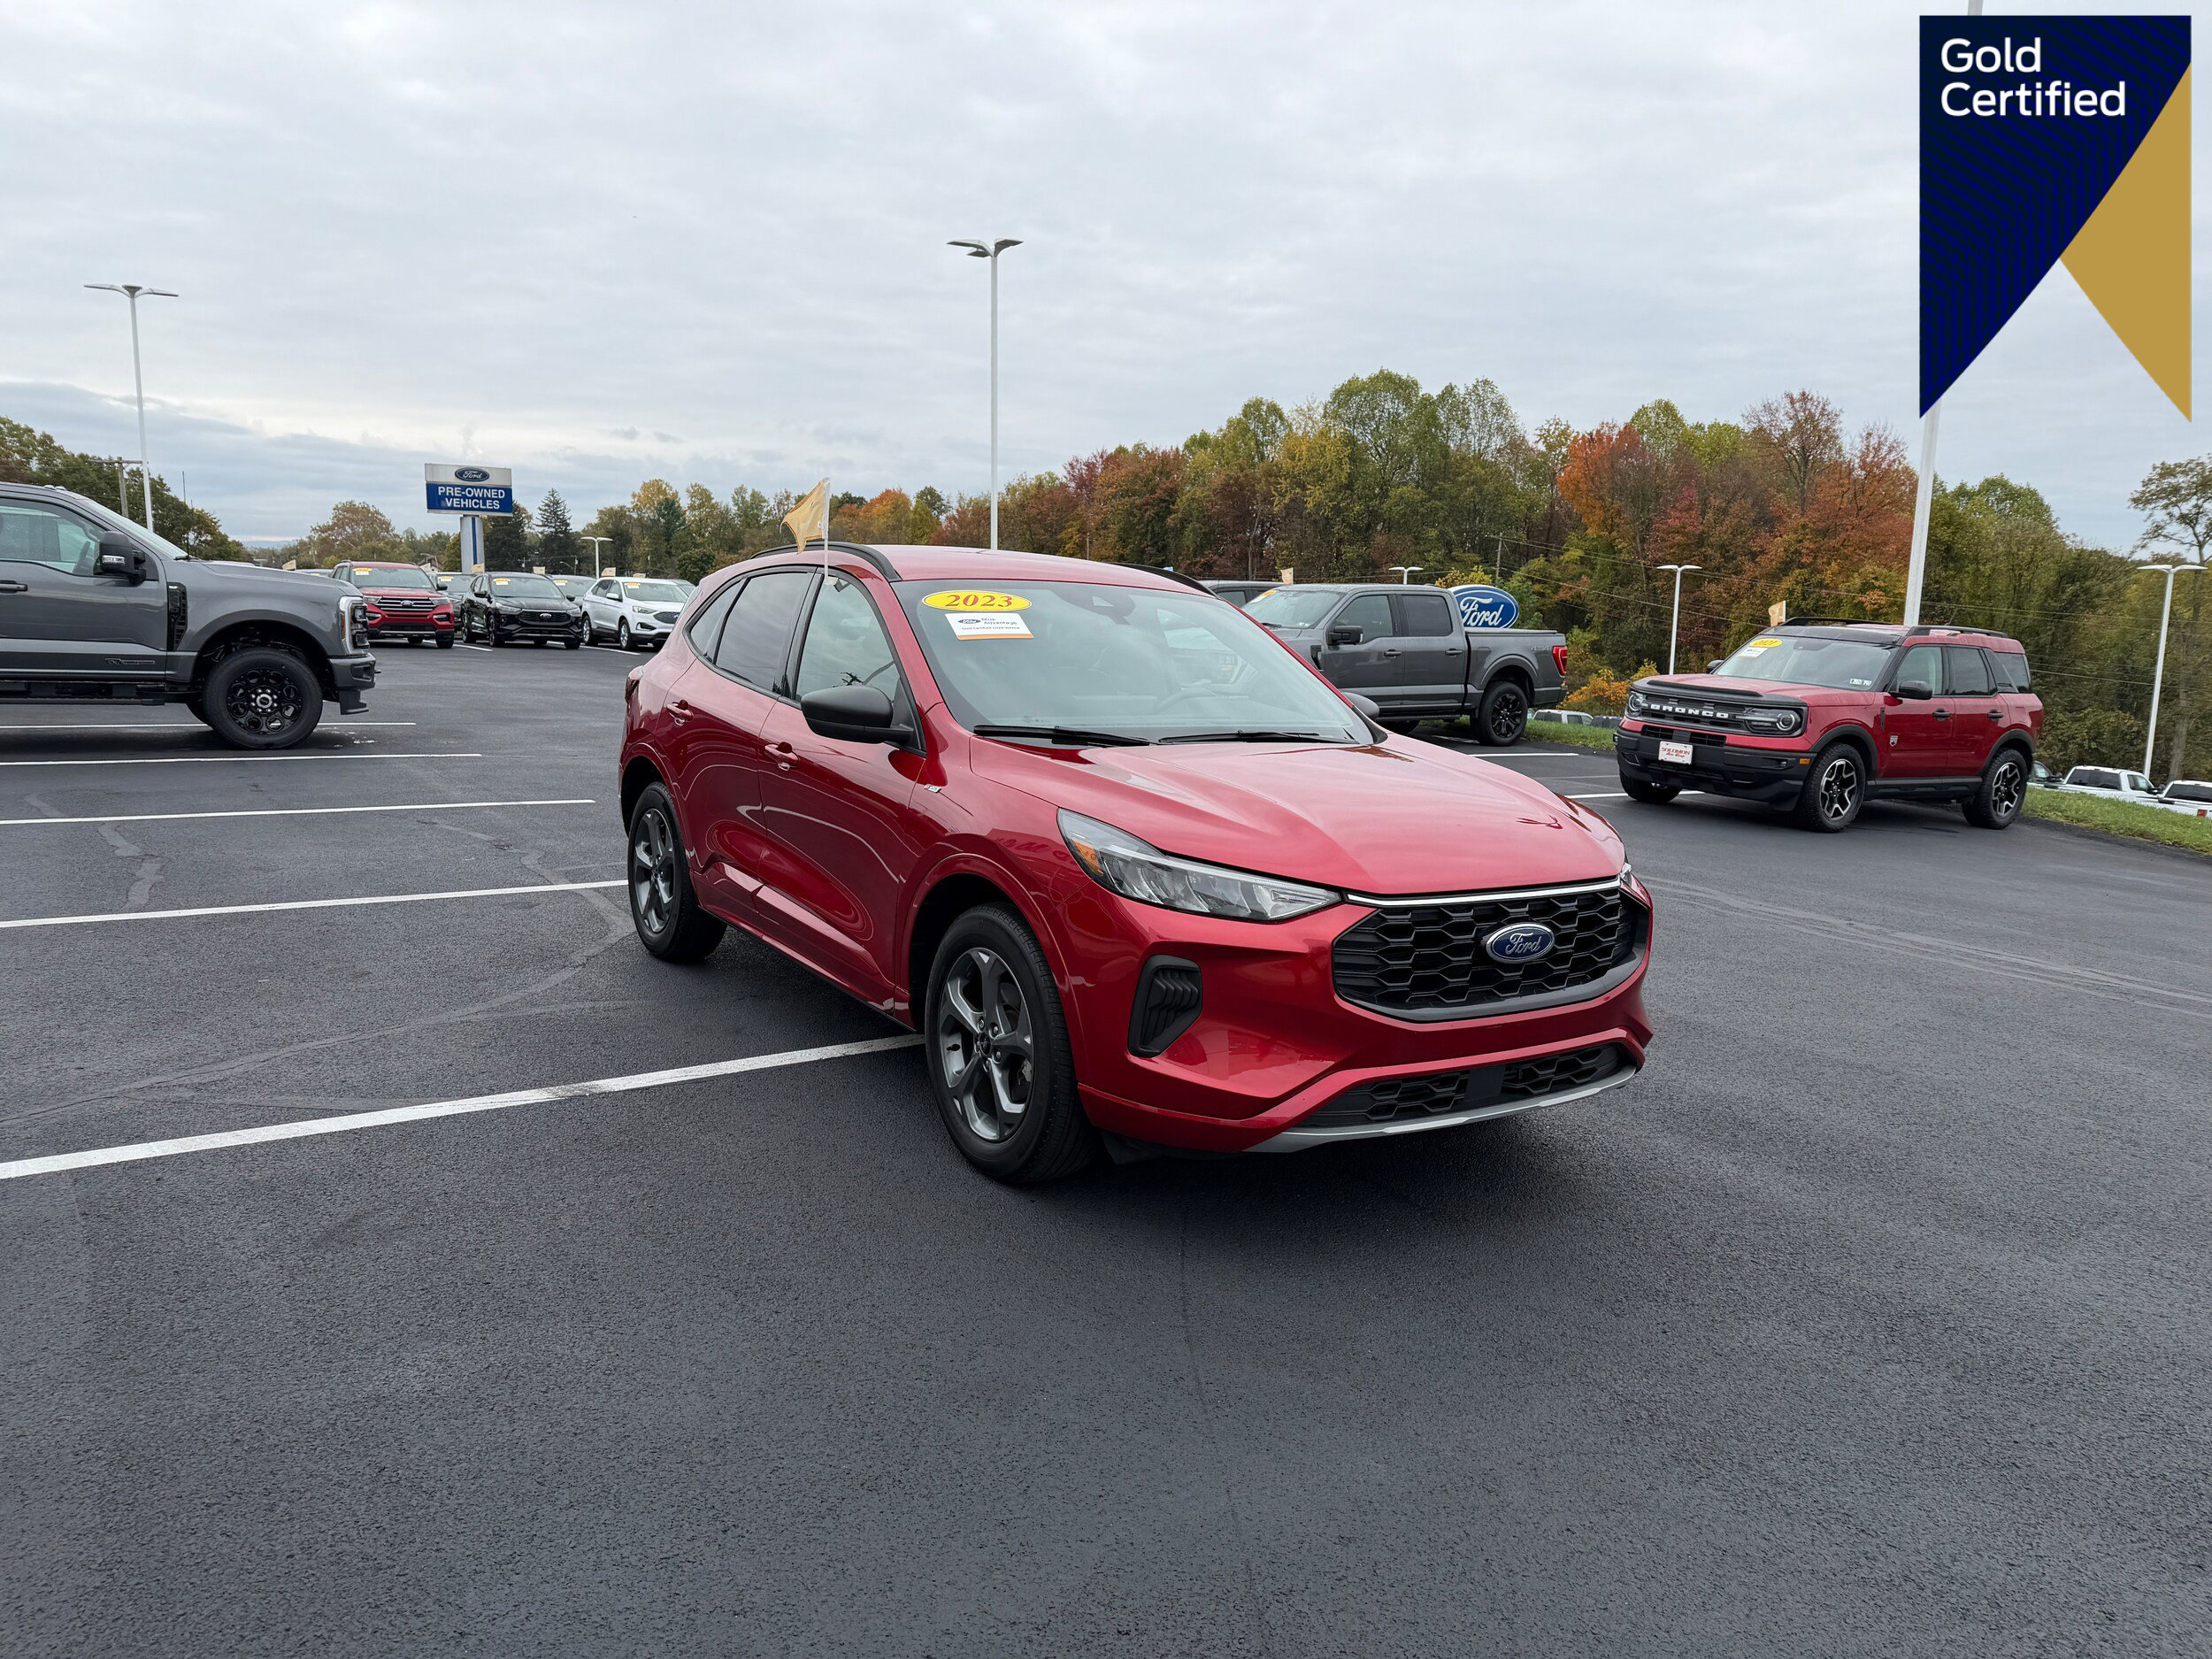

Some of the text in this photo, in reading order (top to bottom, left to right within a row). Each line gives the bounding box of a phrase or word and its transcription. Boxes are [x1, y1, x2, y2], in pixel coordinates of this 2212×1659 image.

[462, 470, 483, 479] Ford
[437, 486, 505, 498] PRE-OWNED
[445, 497, 500, 510] VEHICLES
[945, 594, 1012, 608] 2023
[1460, 596, 1504, 626] Ford
[1650, 703, 1729, 719] BRONCO
[1505, 932, 1542, 955] Ford
